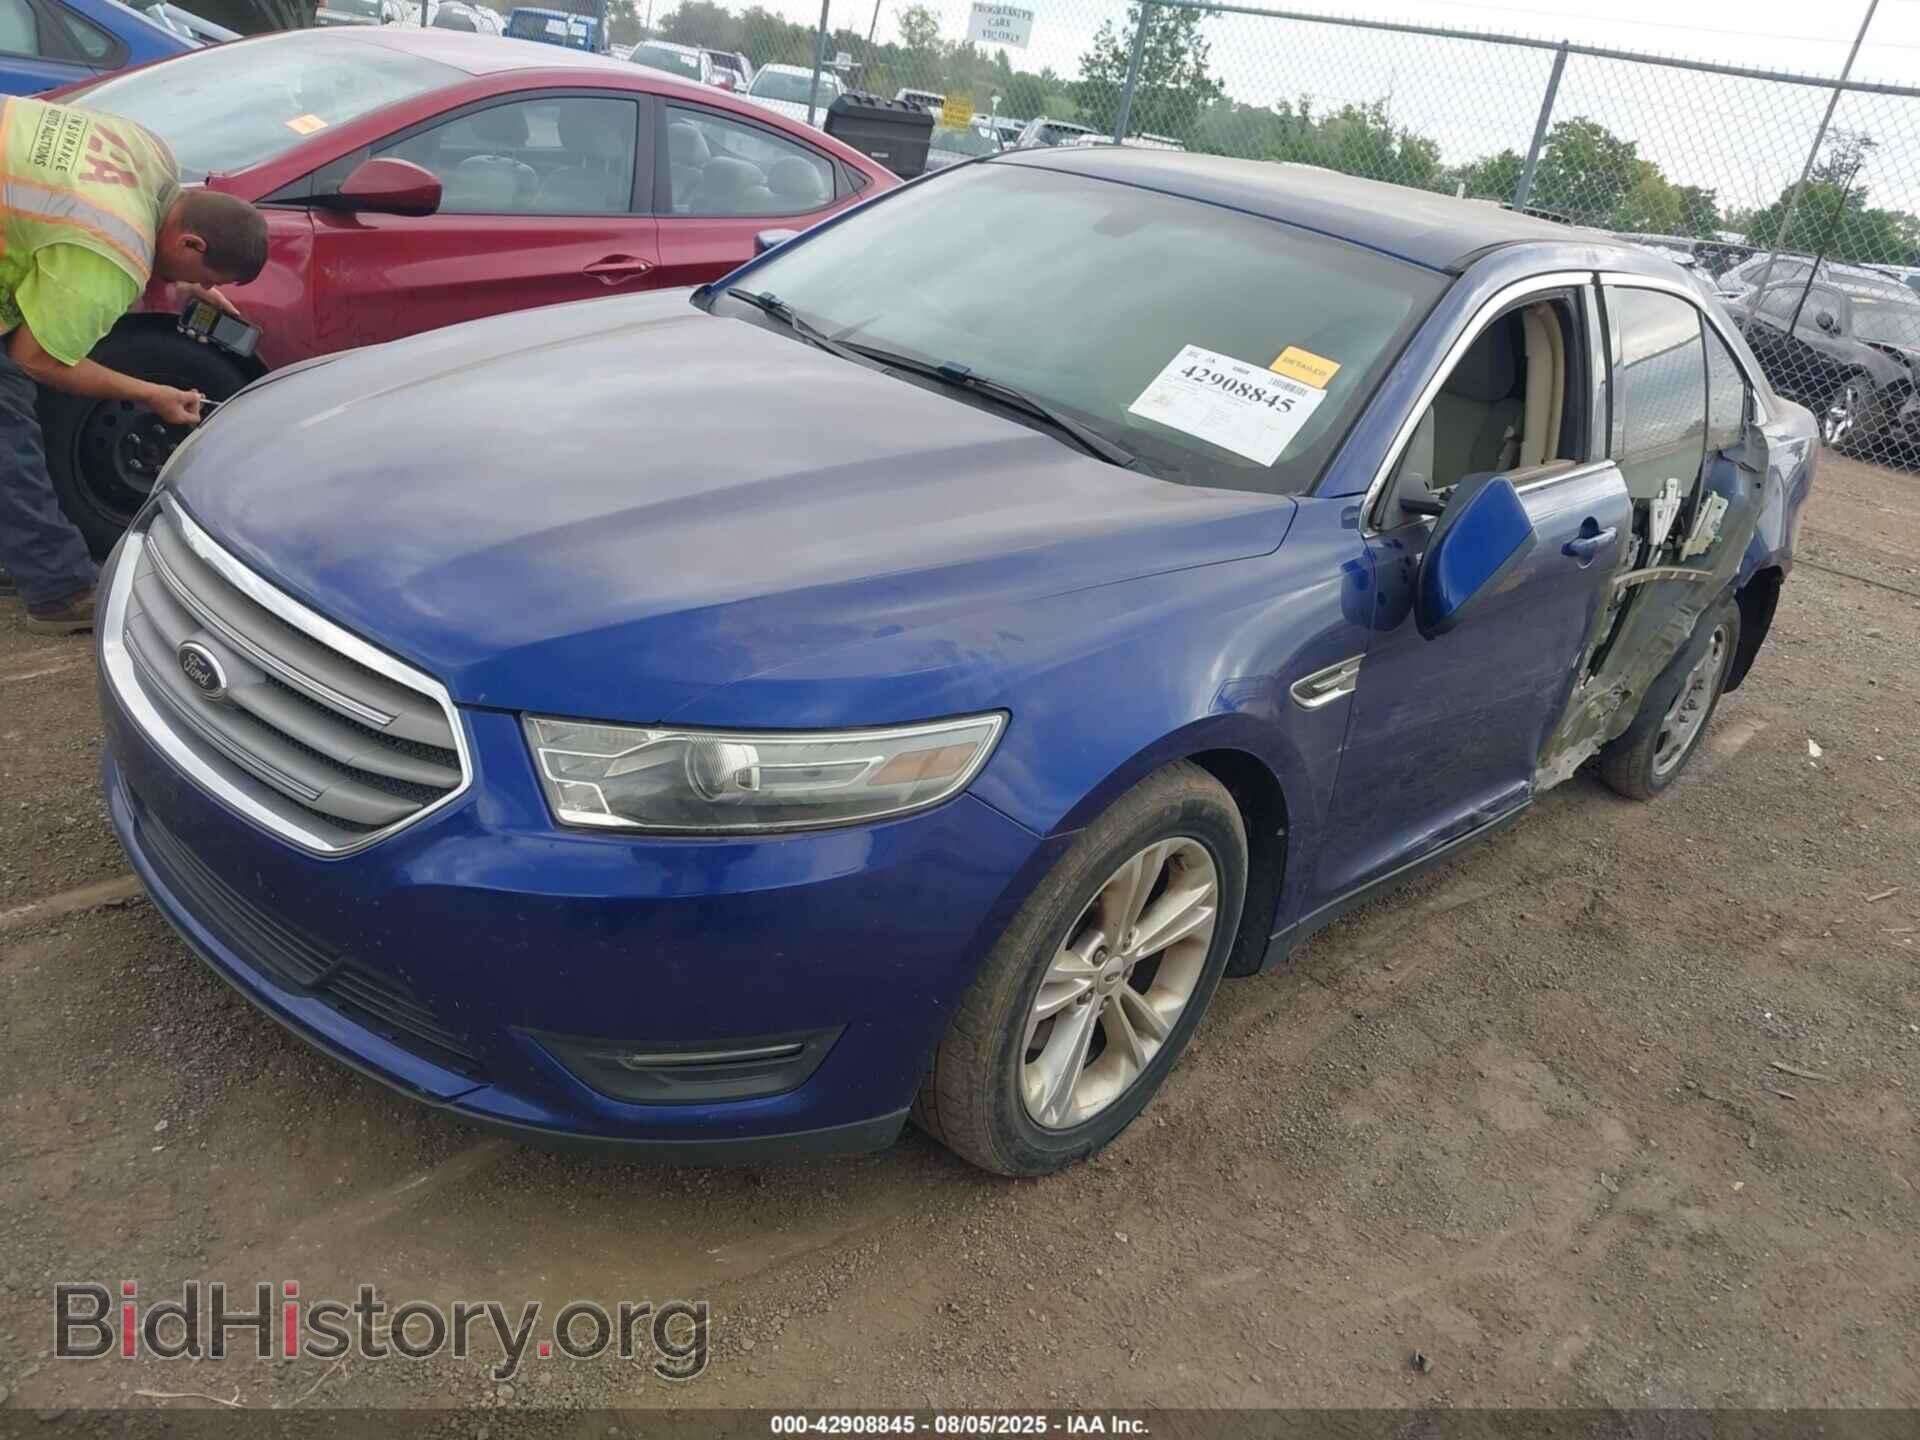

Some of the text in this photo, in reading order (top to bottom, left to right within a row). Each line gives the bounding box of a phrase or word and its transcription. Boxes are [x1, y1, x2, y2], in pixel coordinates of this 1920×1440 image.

[34, 126, 56, 168] AUCTIONS
[56, 113, 82, 172] INSURANCE
[1181, 365, 1296, 413] 42908845
